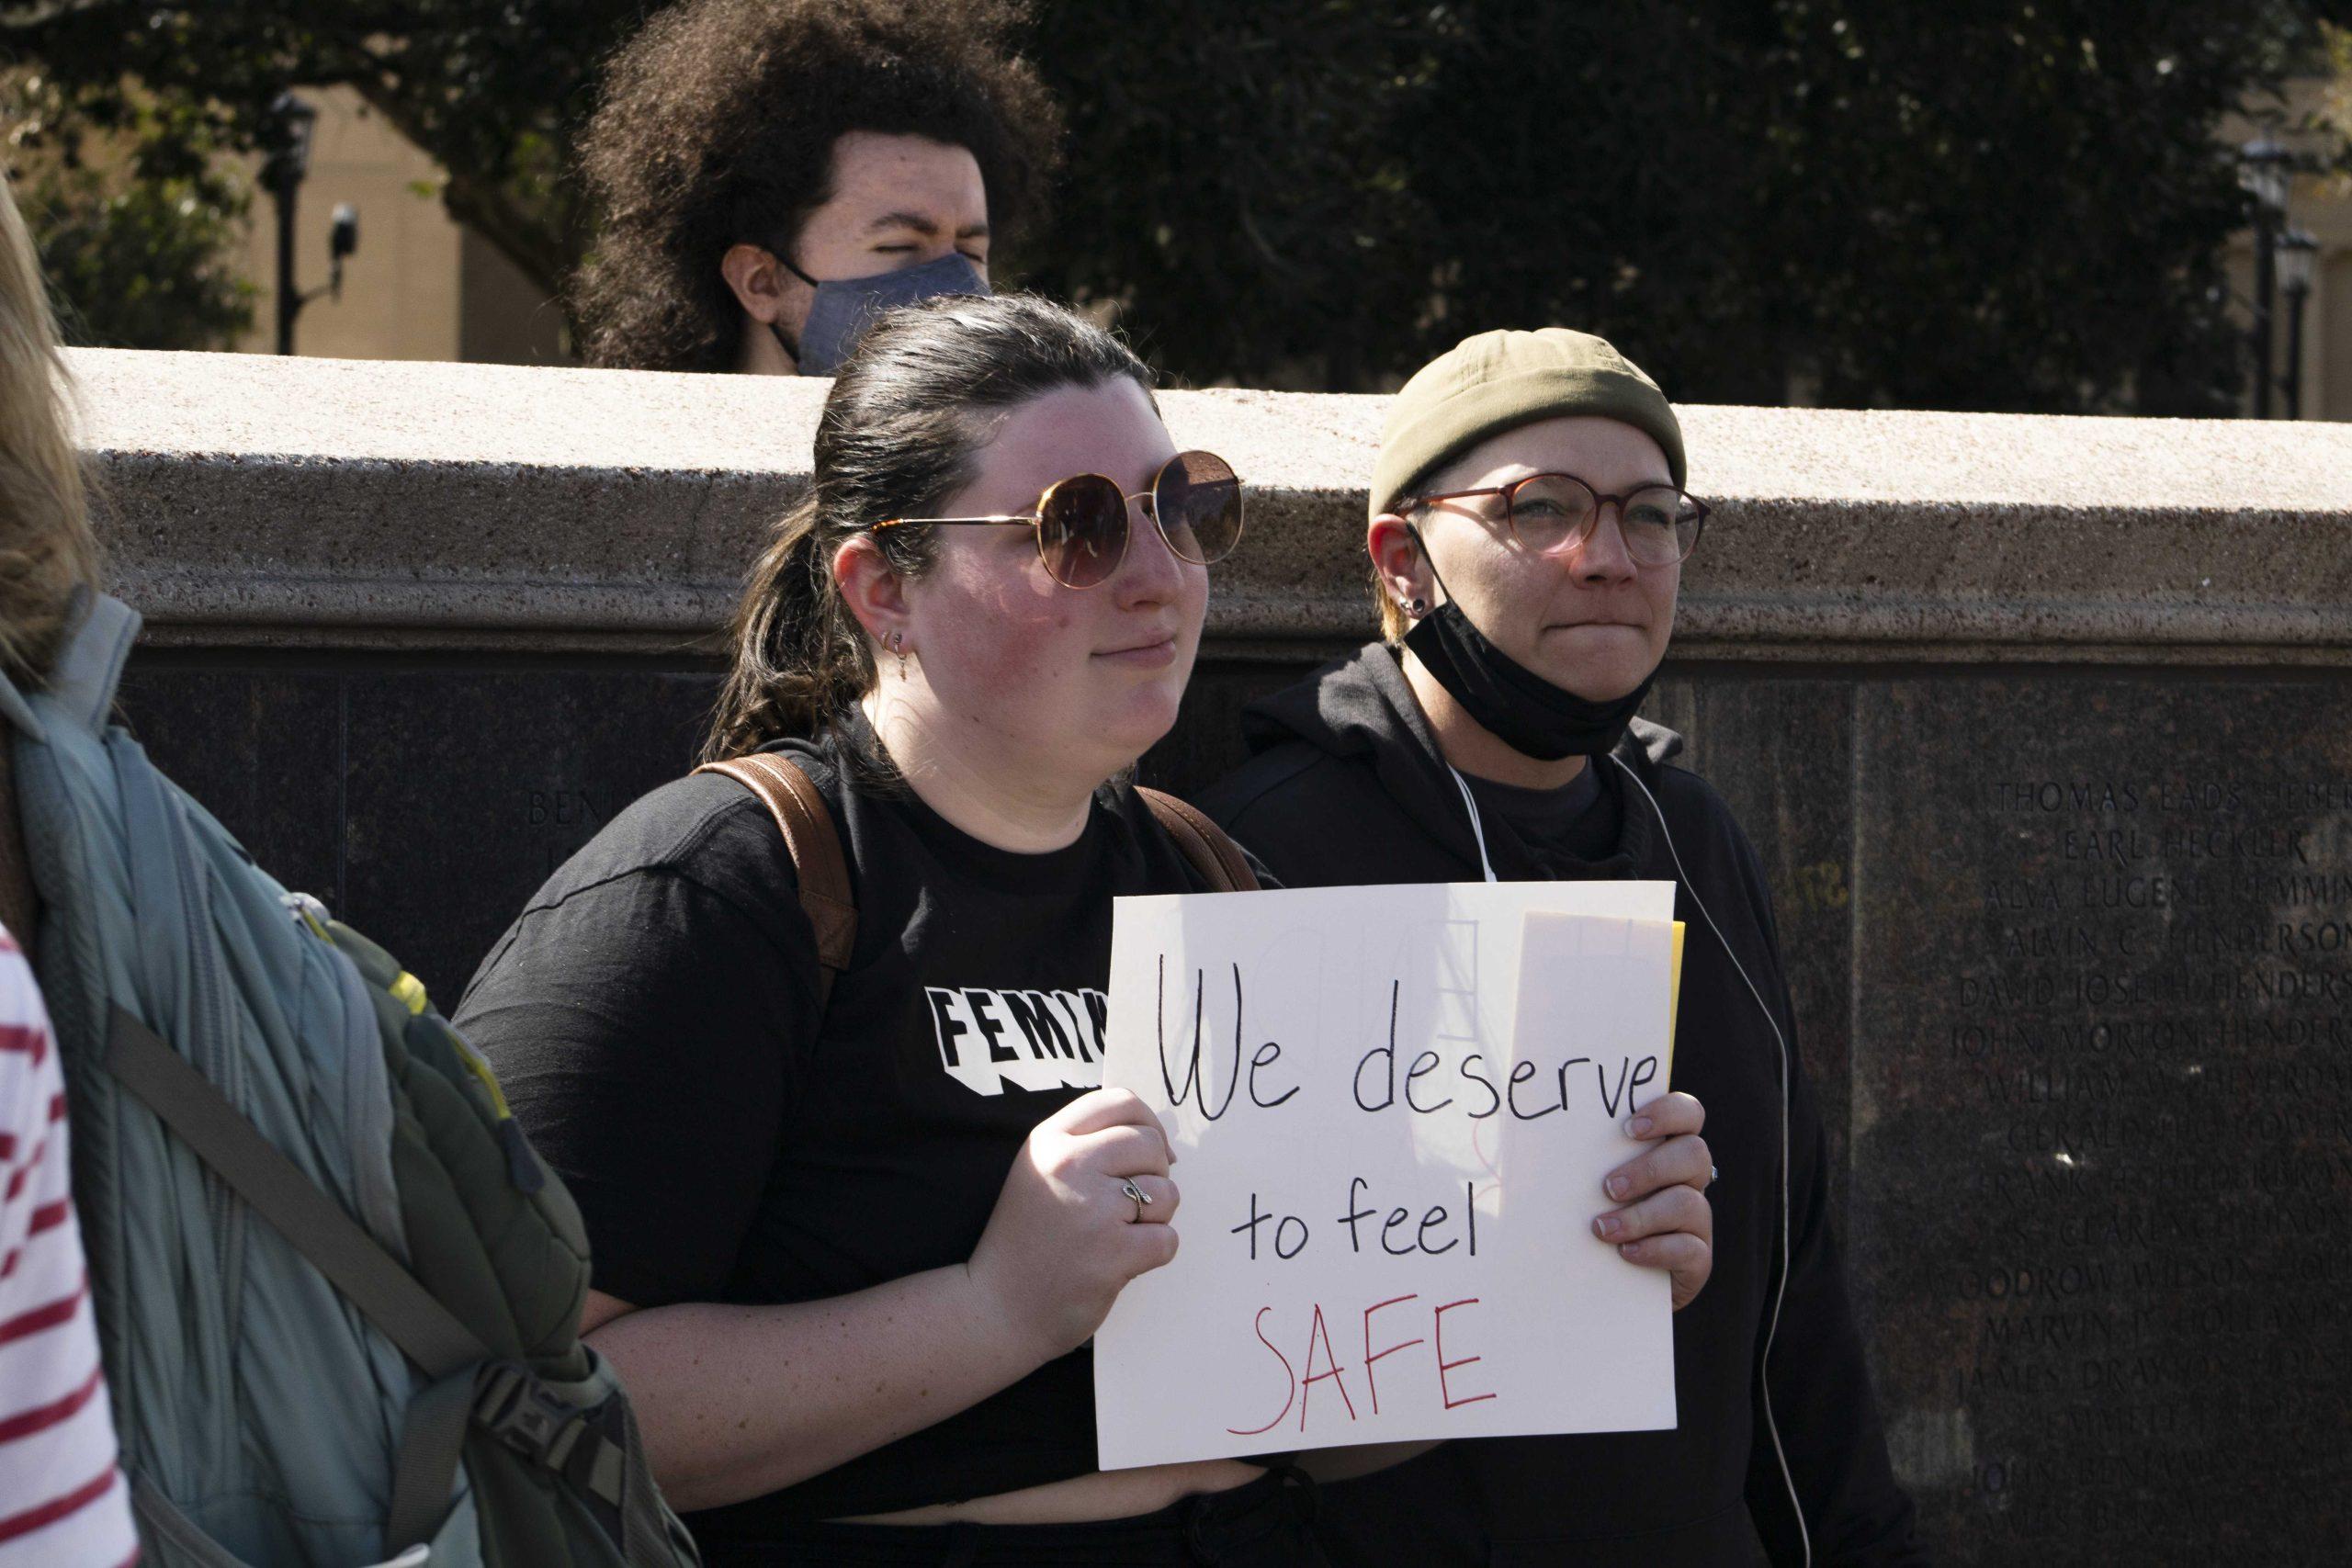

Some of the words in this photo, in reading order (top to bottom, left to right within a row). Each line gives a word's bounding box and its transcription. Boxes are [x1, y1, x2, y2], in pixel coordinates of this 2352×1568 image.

[1996, 782, 2139, 813] THOMAS
[2065, 829, 2144, 867] EARL
[1985, 879, 2061, 909] ALVA
[2007, 927, 2097, 958] ALVIN
[1960, 974, 2054, 1008] DAVID
[1157, 953, 1301, 1122] We
[1352, 978, 1658, 1121] deserve
[1950, 1022, 2043, 1059] JOHN
[1230, 1191, 1310, 1260] to
[1337, 1176, 1477, 1258] feel
[1227, 1293, 1497, 1435] SAFE
